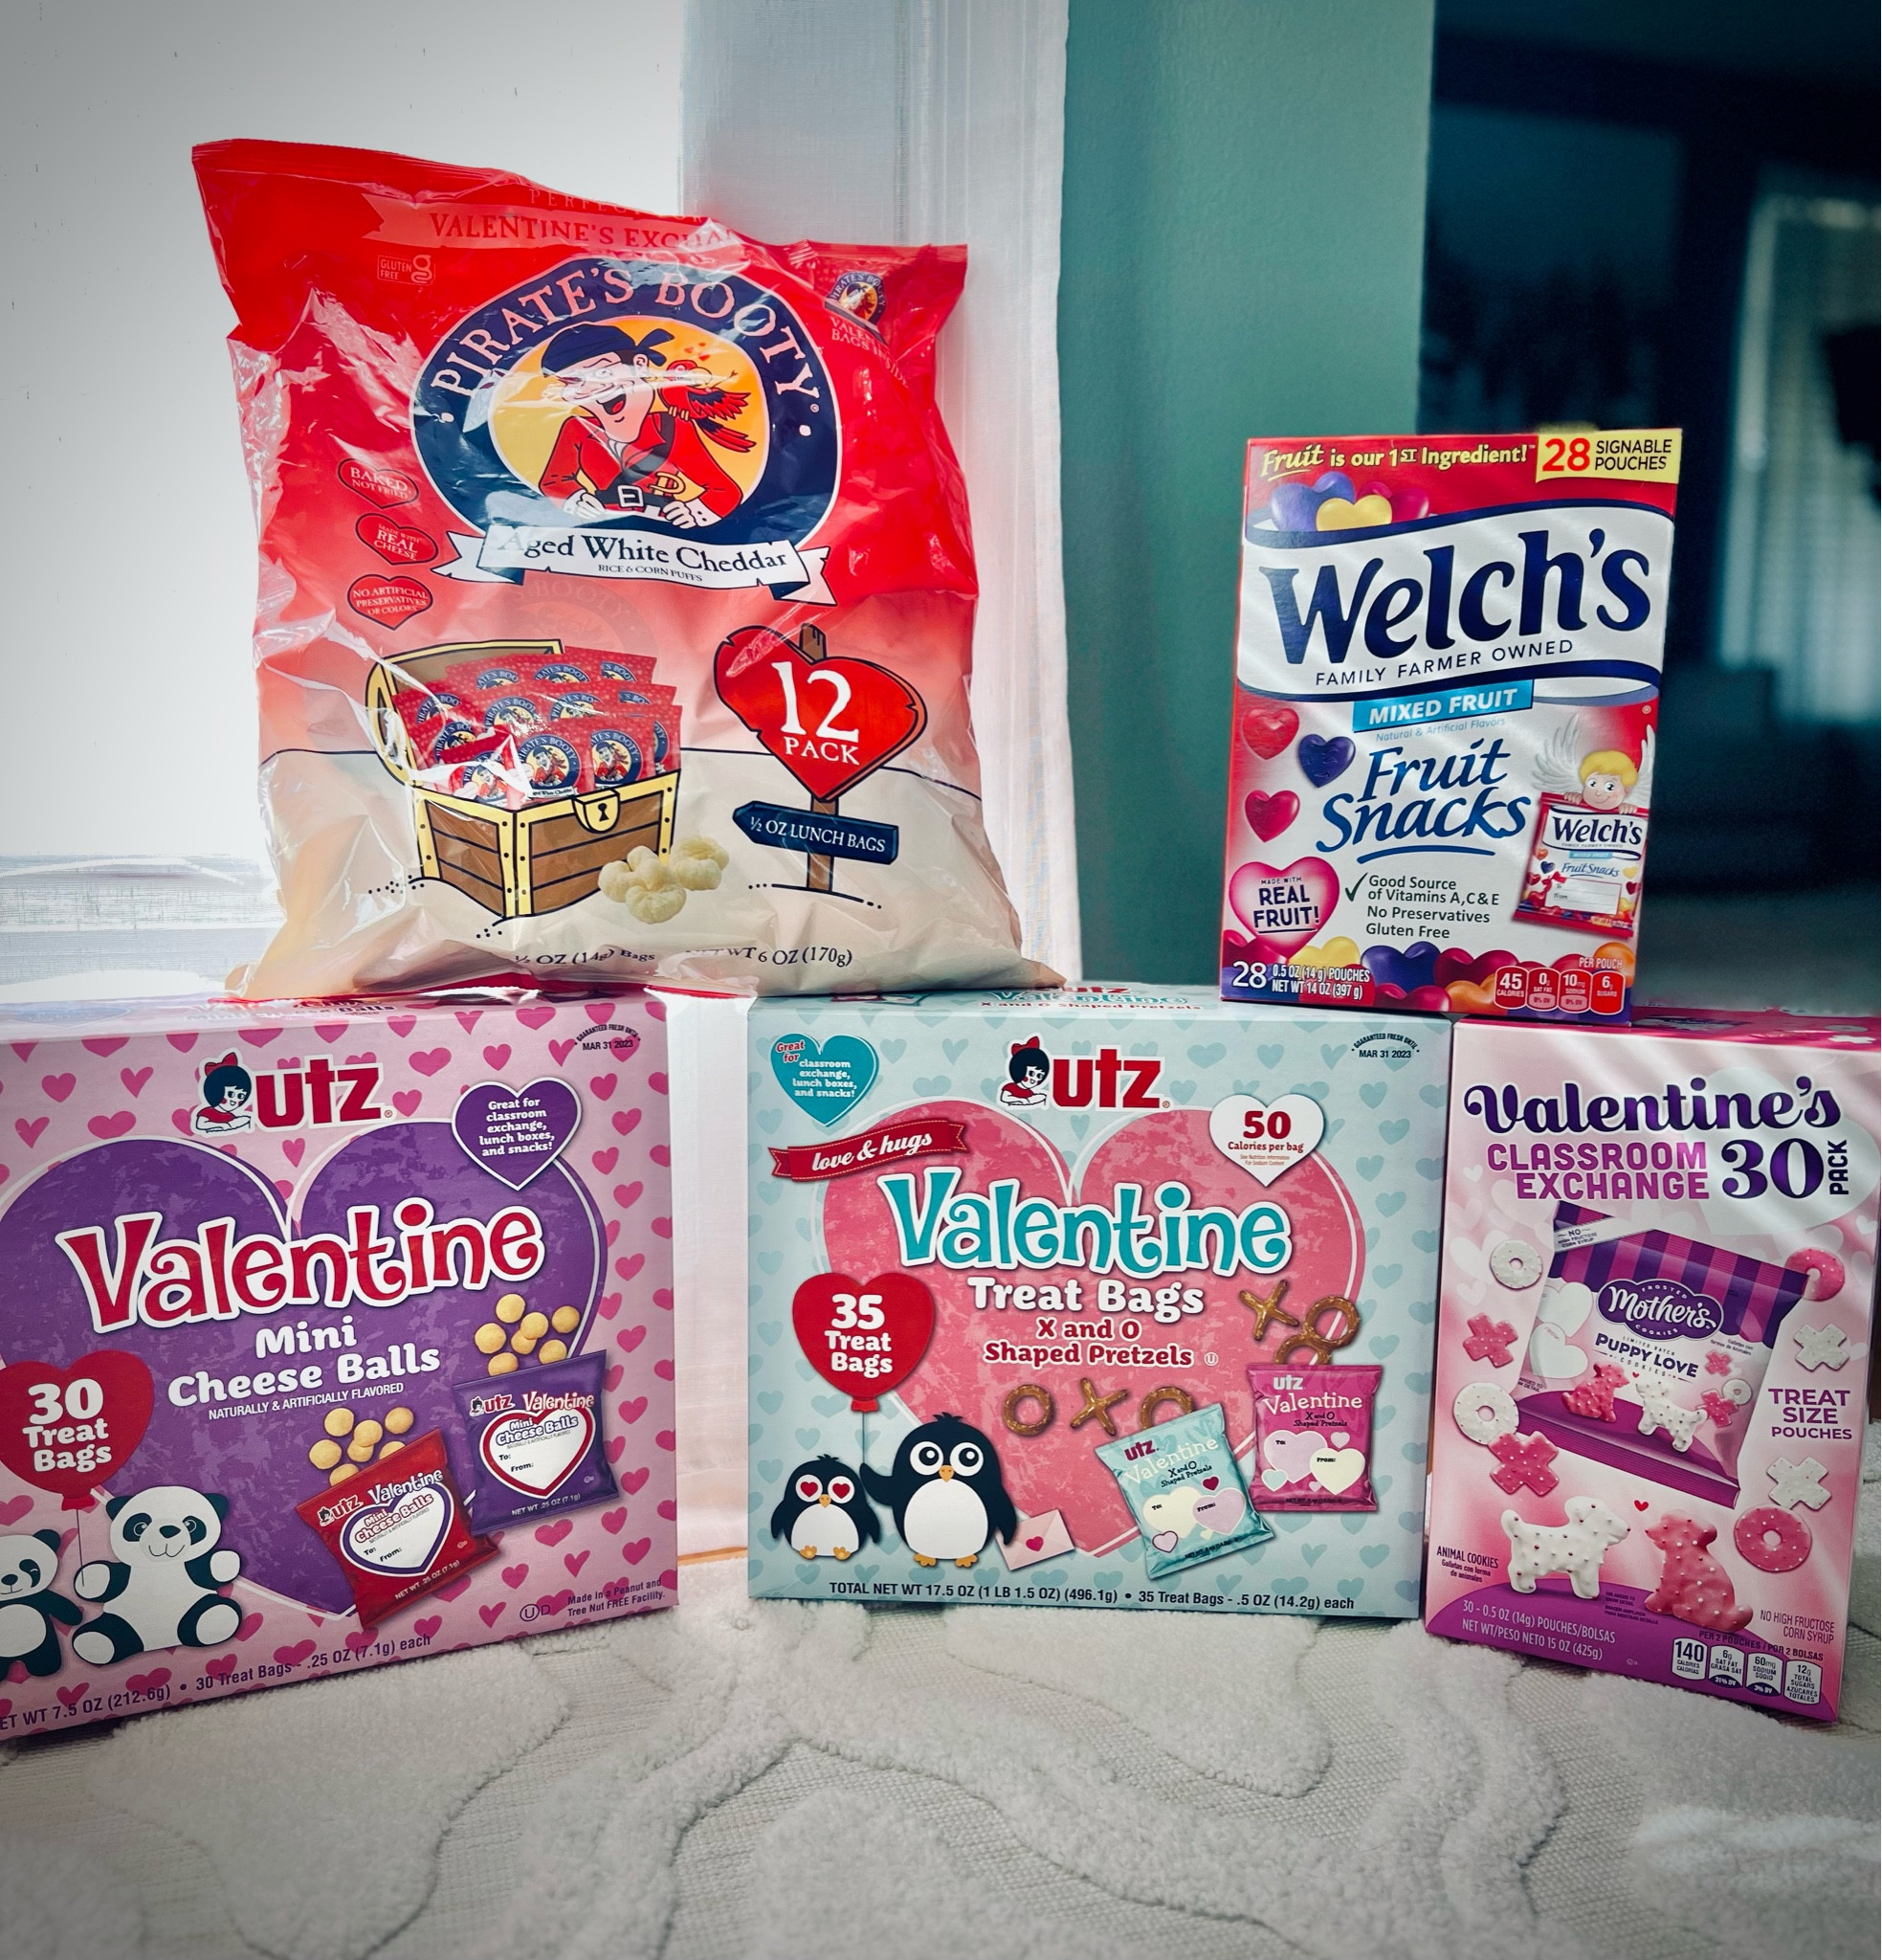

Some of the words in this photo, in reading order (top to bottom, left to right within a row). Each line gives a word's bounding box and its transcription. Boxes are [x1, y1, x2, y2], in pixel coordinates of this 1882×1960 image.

[430, 212, 614, 245] VALENTINE'S
[380, 258, 411, 274] GLUTEN
[380, 270, 400, 280] FREE
[431, 267, 634, 398] PIRATE'S
[655, 273, 820, 400] BOOTY
[1541, 437, 1591, 472] 28
[1595, 439, 1672, 454] SIGNABLE
[1260, 444, 1324, 478] Fruit
[1351, 451, 1384, 467] our
[1421, 444, 1527, 470] Ingredient!
[1594, 456, 1668, 471] POUCHES
[374, 540, 417, 561] CHEESE
[376, 531, 418, 553] REAL
[498, 532, 574, 558] Aged
[582, 534, 670, 563] White
[675, 546, 787, 573] Cheddar
[598, 564, 624, 573] RICE
[635, 566, 668, 576] CORN
[670, 569, 703, 582] PUFFS
[356, 596, 427, 608] PRESERVATIVES
[371, 587, 429, 599] ARTIFICIAL
[1259, 527, 1651, 665] Welch's
[1316, 667, 1386, 687] FAMILY
[1398, 651, 1481, 679] FARMER
[1492, 638, 1573, 662] OWNED
[771, 661, 859, 743] 12
[1368, 699, 1443, 725] MIXED
[1450, 688, 1518, 715] FRUIT
[1375, 730, 1413, 742] Natural
[1426, 722, 1469, 735] Artificial
[784, 736, 859, 766] PACK
[1357, 738, 1512, 803] Fruit
[1315, 786, 1532, 853] Snacks
[1552, 816, 1643, 845] Welch's
[790, 823, 844, 846] LUNCH
[848, 834, 886, 853] BAGS
[1368, 875, 1406, 888] Good
[1408, 877, 1457, 890] Source
[1258, 884, 1311, 906] REAL
[1368, 888, 1381, 901] of
[1384, 889, 1447, 904] Vitamins
[1253, 905, 1319, 928] FRUIT!
[1367, 905, 1388, 919] No
[1392, 906, 1491, 924] Preservatives
[1365, 923, 1414, 938] Gluten
[1418, 925, 1450, 939] Free
[772, 949, 798, 966] OZ
[802, 947, 853, 968] (170g)
[1579, 957, 1594, 969] PER
[1596, 957, 1623, 969] POUCH
[1231, 960, 1268, 989] 28
[1328, 968, 1371, 983] POUCHES
[1499, 972, 1522, 991] 45
[1496, 990, 1525, 998] CALORIES
[582, 1041, 602, 1051] MAR
[614, 1039, 633, 1049] 2023
[776, 1040, 806, 1053] Great
[1359, 1049, 1379, 1058] MAR
[1380, 1049, 1390, 1058] 31
[1391, 1050, 1412, 1058] 2023
[784, 1053, 800, 1063] for
[799, 1058, 852, 1068] classroom
[792, 1078, 823, 1087] lunch
[825, 1079, 857, 1090] boxes,
[799, 1069, 851, 1080] exchange,
[1052, 1049, 1162, 1109] utz
[255, 1058, 382, 1129] utz
[488, 1099, 520, 1110] Great
[522, 1097, 541, 1108] for
[794, 1088, 814, 1097] and
[816, 1089, 855, 1098] snacks!
[1464, 1076, 1842, 1134] Valentine's
[486, 1109, 547, 1123] classroom
[487, 1121, 547, 1133] exchange,
[1243, 1110, 1292, 1140] 50
[478, 1133, 515, 1146] lunch
[517, 1131, 555, 1142] boxes,
[481, 1145, 505, 1157] and
[507, 1141, 553, 1154] snacks!
[1228, 1141, 1268, 1151] Calories
[1286, 1142, 1304, 1154] bag
[811, 1151, 855, 1171] love
[879, 1131, 933, 1156] hugs
[1487, 1142, 1707, 1171] CLASSROOM
[1720, 1138, 1826, 1199] 30
[1828, 1139, 1849, 1195] PACK
[1517, 1172, 1710, 1200] EXCHANGE
[881, 1171, 1287, 1276] Valentine
[60, 1200, 542, 1329] Valentine
[830, 1293, 884, 1330] 35
[967, 1278, 1083, 1312] Treat
[1097, 1279, 1205, 1324] Bags
[1607, 1285, 1716, 1329] Mother's
[255, 1314, 358, 1359] Mini
[824, 1329, 892, 1353] Treat
[1063, 1320, 1116, 1340] and
[830, 1351, 893, 1379] Bags
[985, 1343, 1081, 1368] Shaped
[1089, 1344, 1193, 1368] Pretzels
[1595, 1332, 1652, 1362] PUPPY
[1652, 1353, 1699, 1378] LOVE
[167, 1364, 323, 1407] Cheese
[337, 1343, 441, 1384] Balls
[28, 1377, 104, 1425] 30
[208, 1401, 270, 1420] NATURALLY
[282, 1390, 349, 1410] ARTIFICIALLY
[351, 1382, 405, 1401] FLAVORED
[521, 1391, 595, 1412] Valentine
[1262, 1392, 1363, 1416] Valentine
[1767, 1388, 1850, 1407] TREAT
[1782, 1407, 1839, 1425] SIZE
[22, 1417, 109, 1448] Treat
[496, 1424, 544, 1446] Cheese
[1771, 1426, 1853, 1440] POUCHES
[33, 1443, 113, 1473] Bags
[1123, 1437, 1220, 1484] Valentine
[366, 1469, 443, 1504] Valentine
[1467, 1550, 1499, 1570] COOKIES
[567, 1593, 592, 1605] Made
[567, 1605, 587, 1617] Tree
[589, 1602, 605, 1613] Nut
[607, 1597, 630, 1611] FREE
[631, 1591, 666, 1605] Facility.
[830, 1582, 870, 1594] TOTAL
[873, 1583, 898, 1595] NET
[900, 1584, 922, 1596] WT
[925, 1584, 954, 1597] 17.5
[958, 1585, 975, 1597] OZ
[994, 1586, 1011, 1598] LB
[1014, 1586, 1034, 1599] 1.5
[1064, 1587, 1118, 1604] (496.1g)
[1139, 1591, 1155, 1603] 35
[1158, 1591, 1189, 1604] Treat
[1192, 1592, 1225, 1606] Bags
[1252, 1593, 1271, 1606] OZ
[1323, 1596, 1355, 1609] each
[1463, 1599, 1474, 1614] 30
[1482, 1604, 1496, 1617] 0.5
[1537, 1616, 1616, 1644] POUCHES/BOLSAS
[1760, 1609, 1772, 1622] NO
[1794, 1616, 1835, 1634] FRUCTOSE
[1559, 1638, 1570, 1654] OZ
[1674, 1640, 1705, 1663] 140
[1792, 1648, 1824, 1661] BOLSAS
[23, 1707, 49, 1726] WT
[52, 1704, 78, 1720] 7.5
[107, 1683, 172, 1712] (212.6g)
[218, 1667, 255, 1685] Treat
[257, 1662, 293, 1679] Bags
[399, 1634, 432, 1651] each
